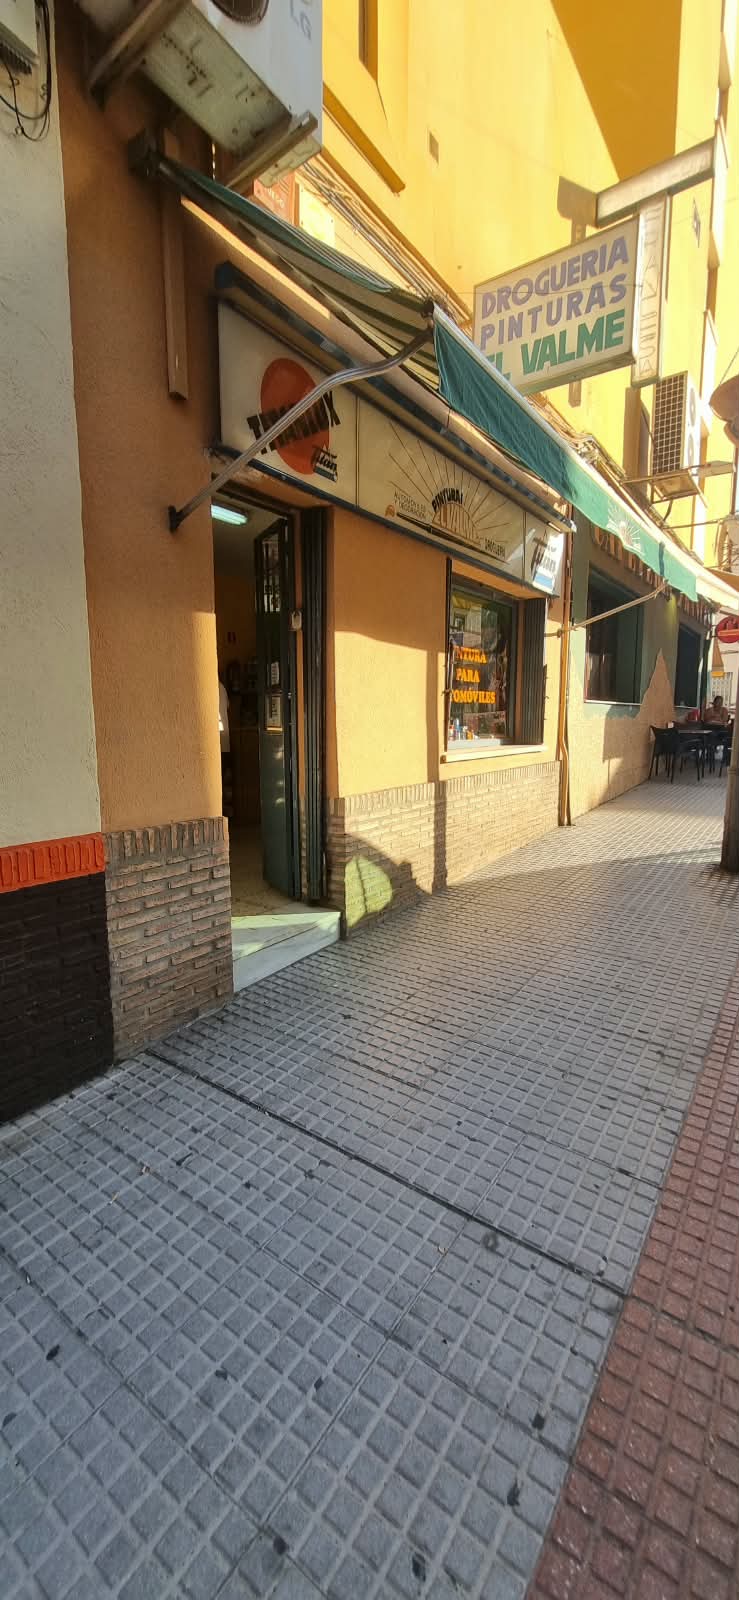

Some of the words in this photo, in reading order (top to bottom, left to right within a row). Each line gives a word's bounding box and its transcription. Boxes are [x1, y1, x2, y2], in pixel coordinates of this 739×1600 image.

[481, 236, 629, 320] DROGUERIA
[480, 273, 627, 351] PINTURAS
[520, 309, 625, 375] VALME
[451, 687, 496, 704] OMÓVILES
[456, 667, 480, 683] PARA
